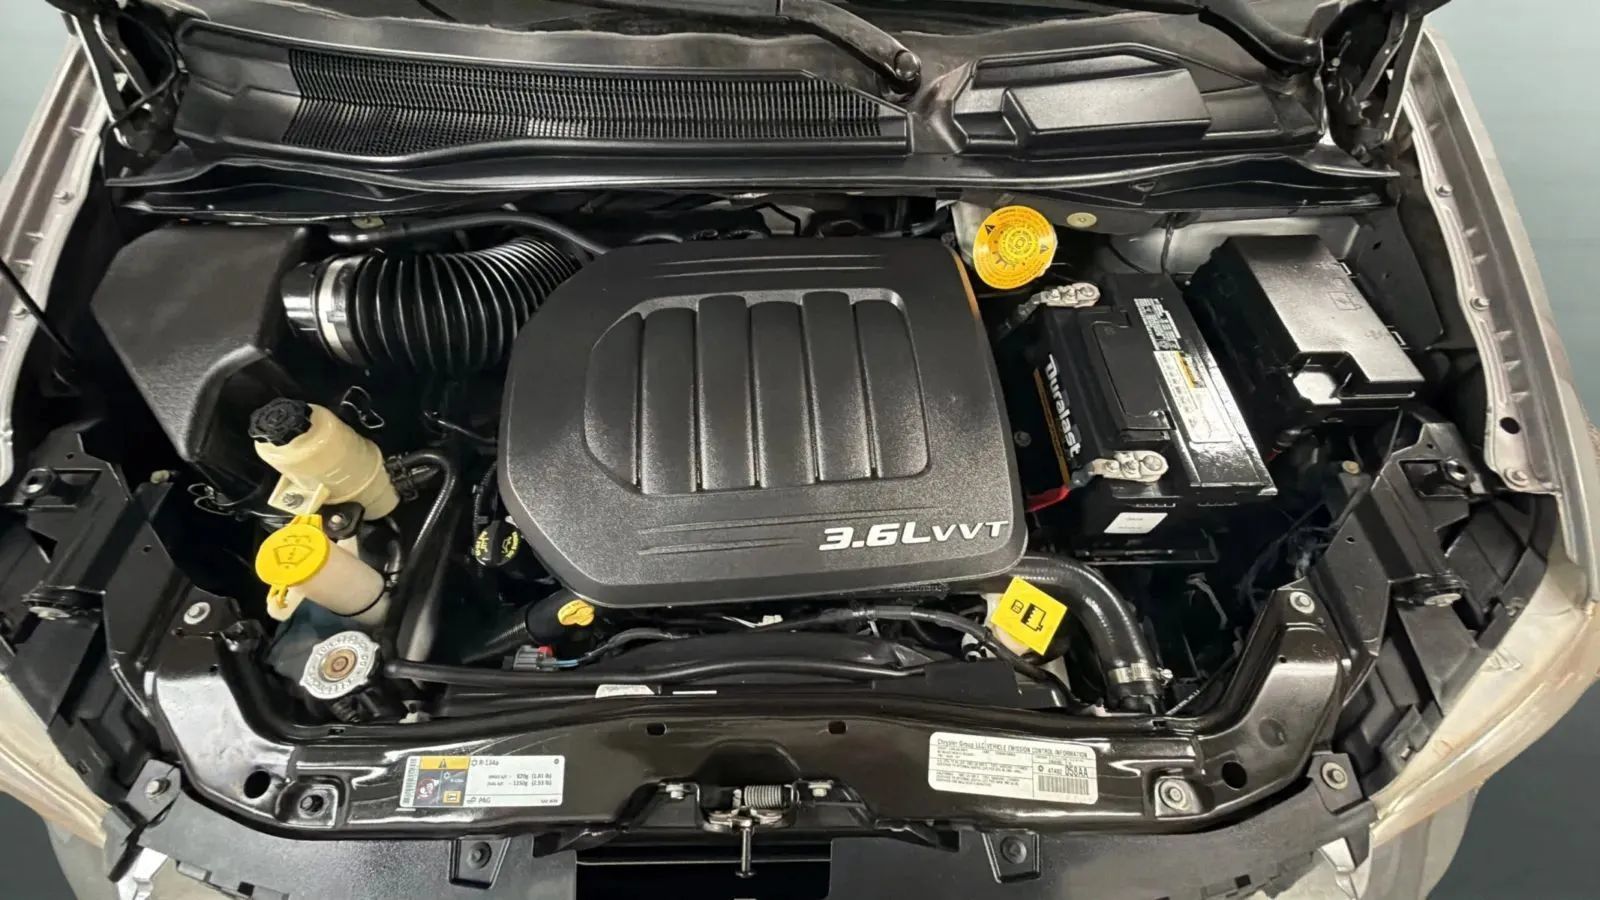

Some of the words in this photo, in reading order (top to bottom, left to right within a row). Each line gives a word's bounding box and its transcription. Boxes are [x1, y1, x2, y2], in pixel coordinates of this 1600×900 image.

[1045, 353, 1081, 458] Duralast
[937, 738, 958, 748] Chrysler
[959, 740, 974, 749] Group
[975, 741, 985, 749] LLC
[1008, 744, 1031, 753] EMISSION
[1032, 747, 1053, 755] CONTROL
[1055, 749, 1088, 758] INFORMATION
